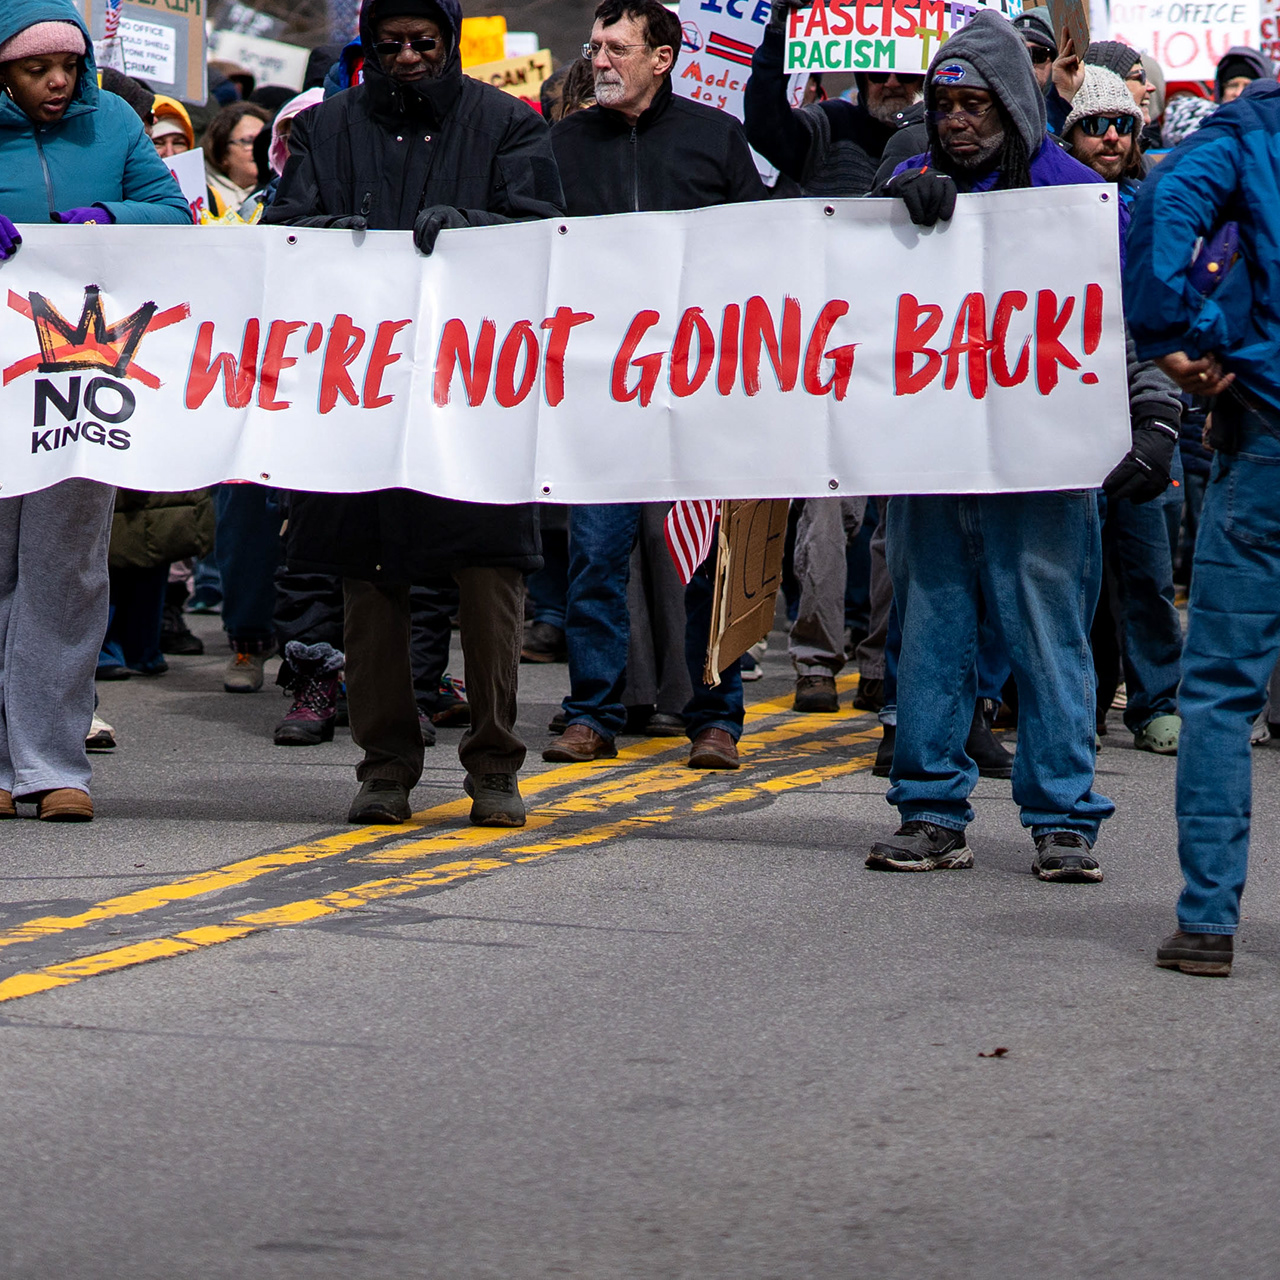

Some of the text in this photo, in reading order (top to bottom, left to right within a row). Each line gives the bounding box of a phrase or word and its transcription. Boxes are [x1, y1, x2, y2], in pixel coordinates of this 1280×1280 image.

[1168, 3, 1247, 24] OFFICE
[133, 24, 164, 36] OFFICE
[125, 61, 157, 75] CRIME
[788, 40, 896, 69] RACISM
[184, 283, 1104, 414] WE'RE NOT GOING BACK!
[33, 376, 136, 427] NO
[31, 421, 131, 454] KINGS
